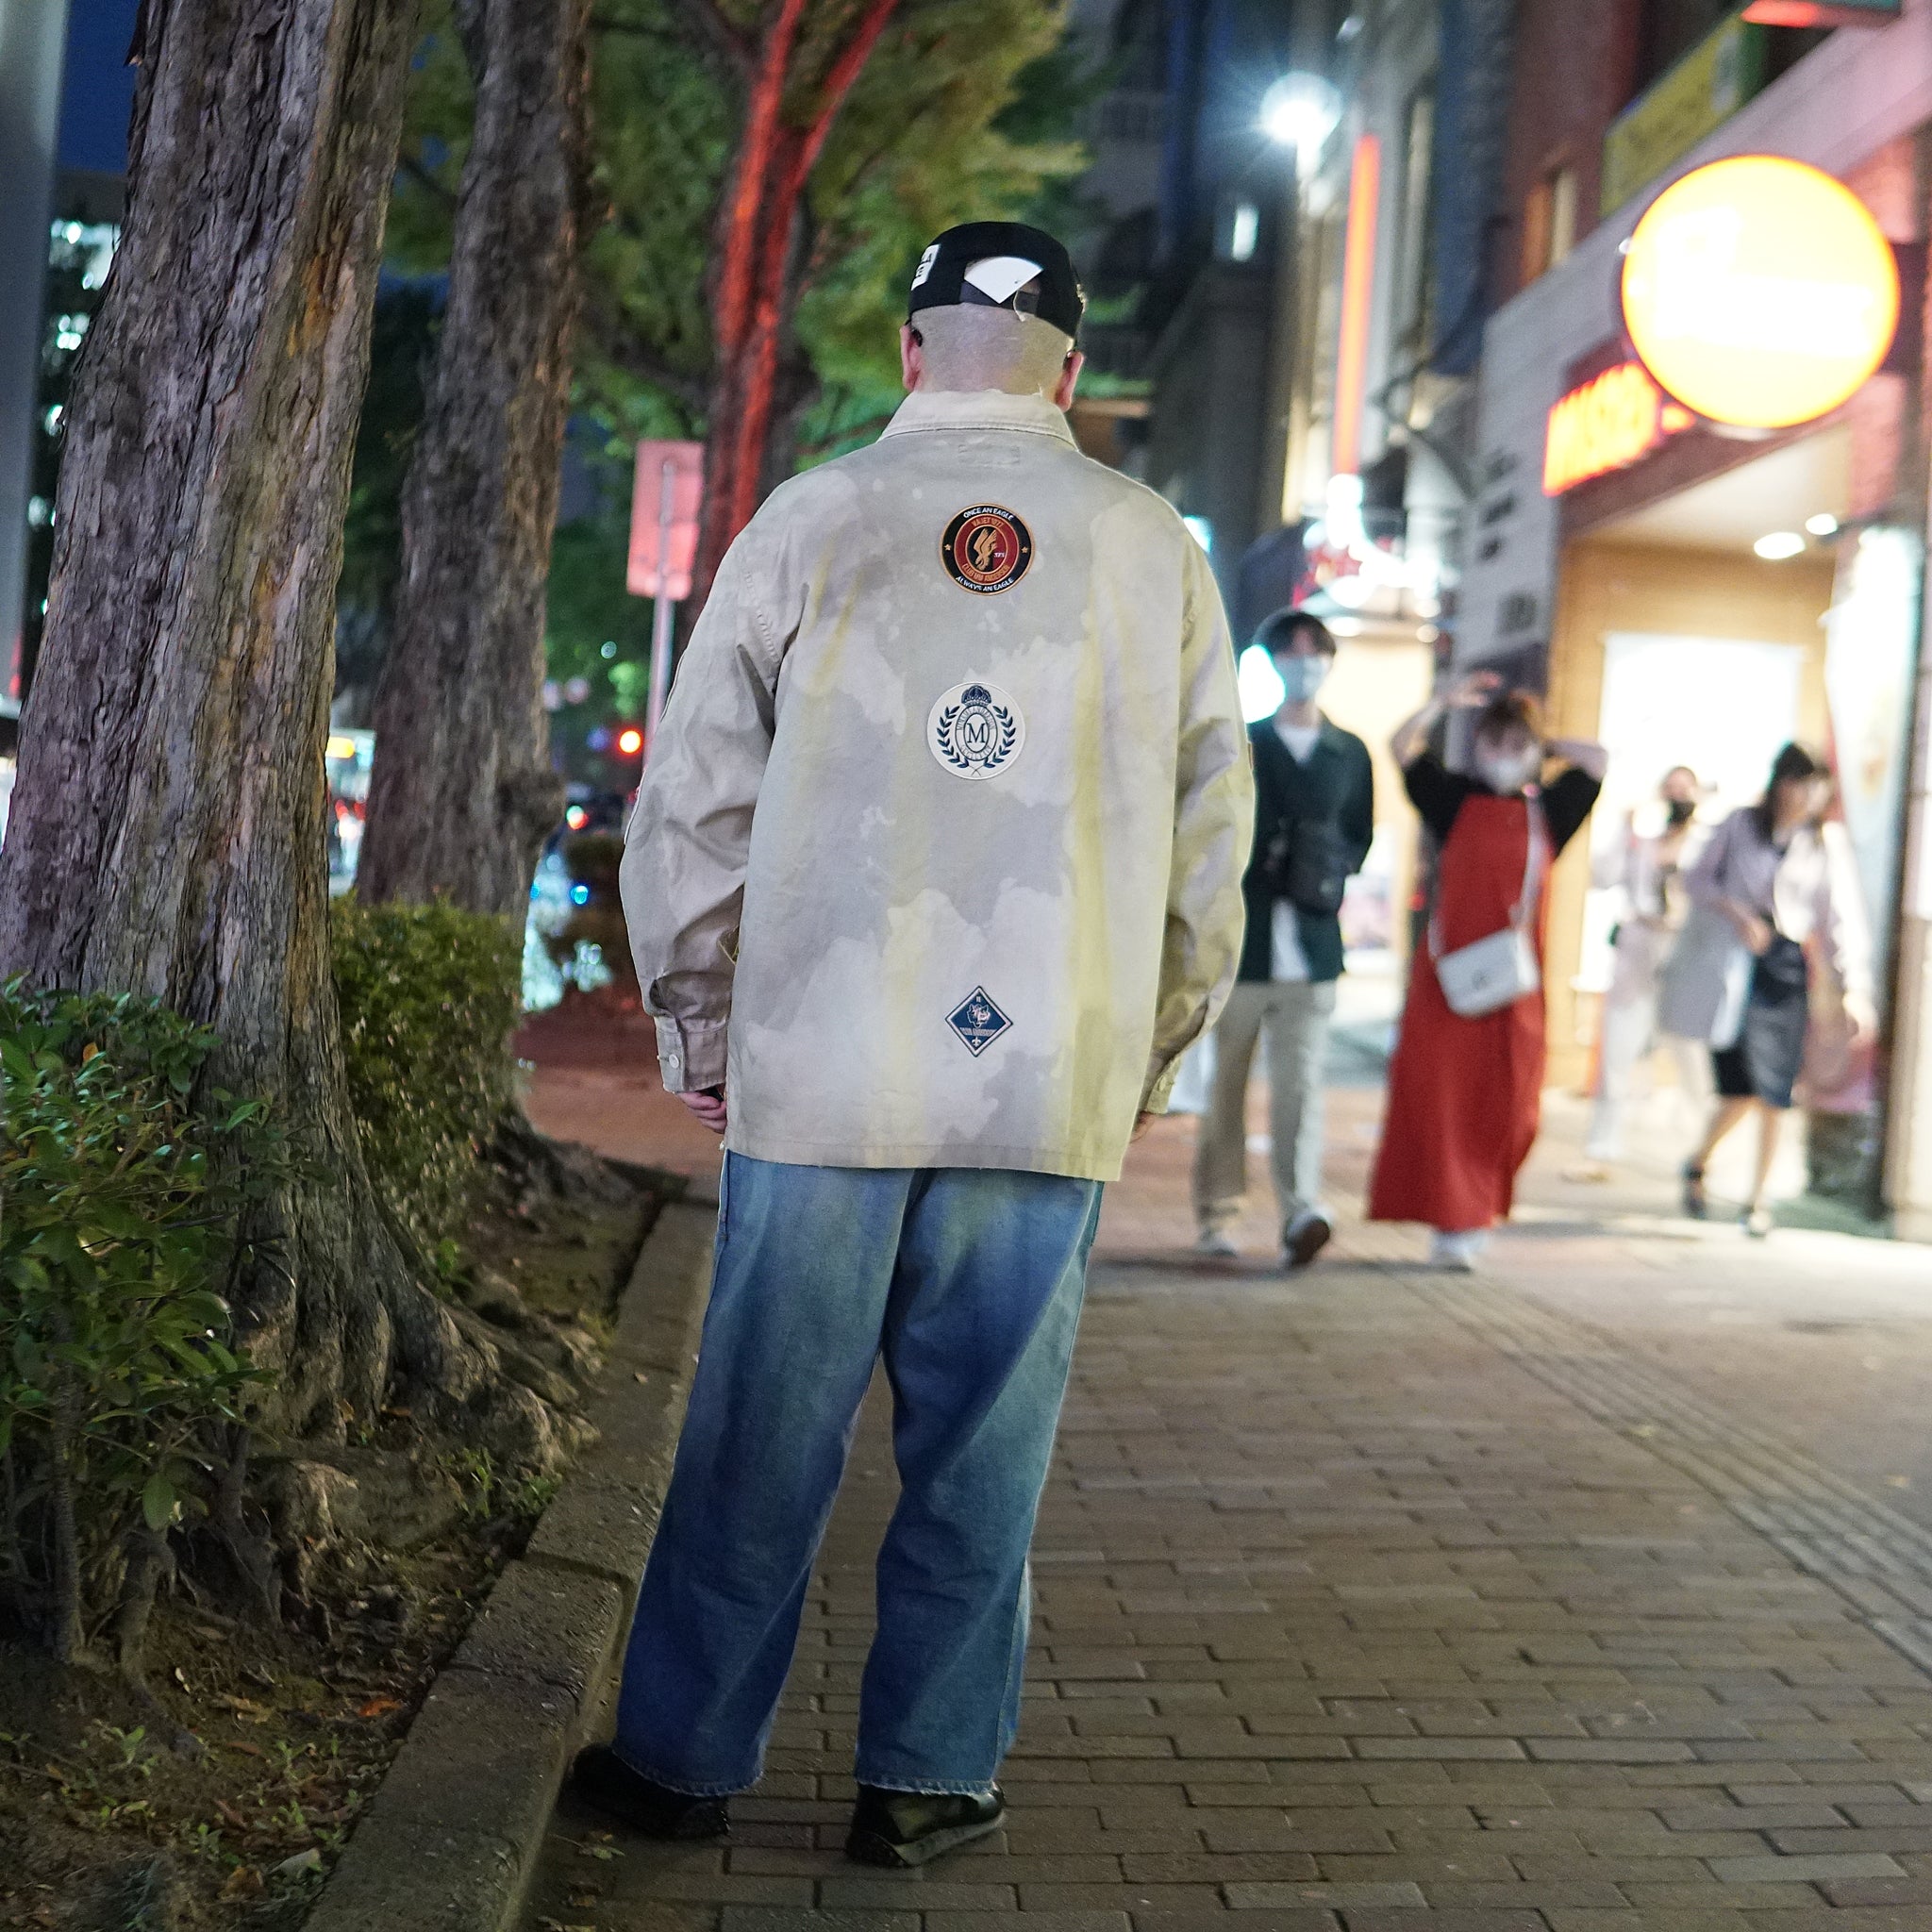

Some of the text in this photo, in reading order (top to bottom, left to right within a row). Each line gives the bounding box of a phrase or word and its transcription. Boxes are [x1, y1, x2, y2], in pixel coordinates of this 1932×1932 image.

[963, 508, 981, 518] ONCE
[993, 508, 1014, 521] EAGLE
[956, 576, 982, 591] ALWAYS
[993, 577, 1015, 591] EAGLE
[967, 723, 985, 742] M
